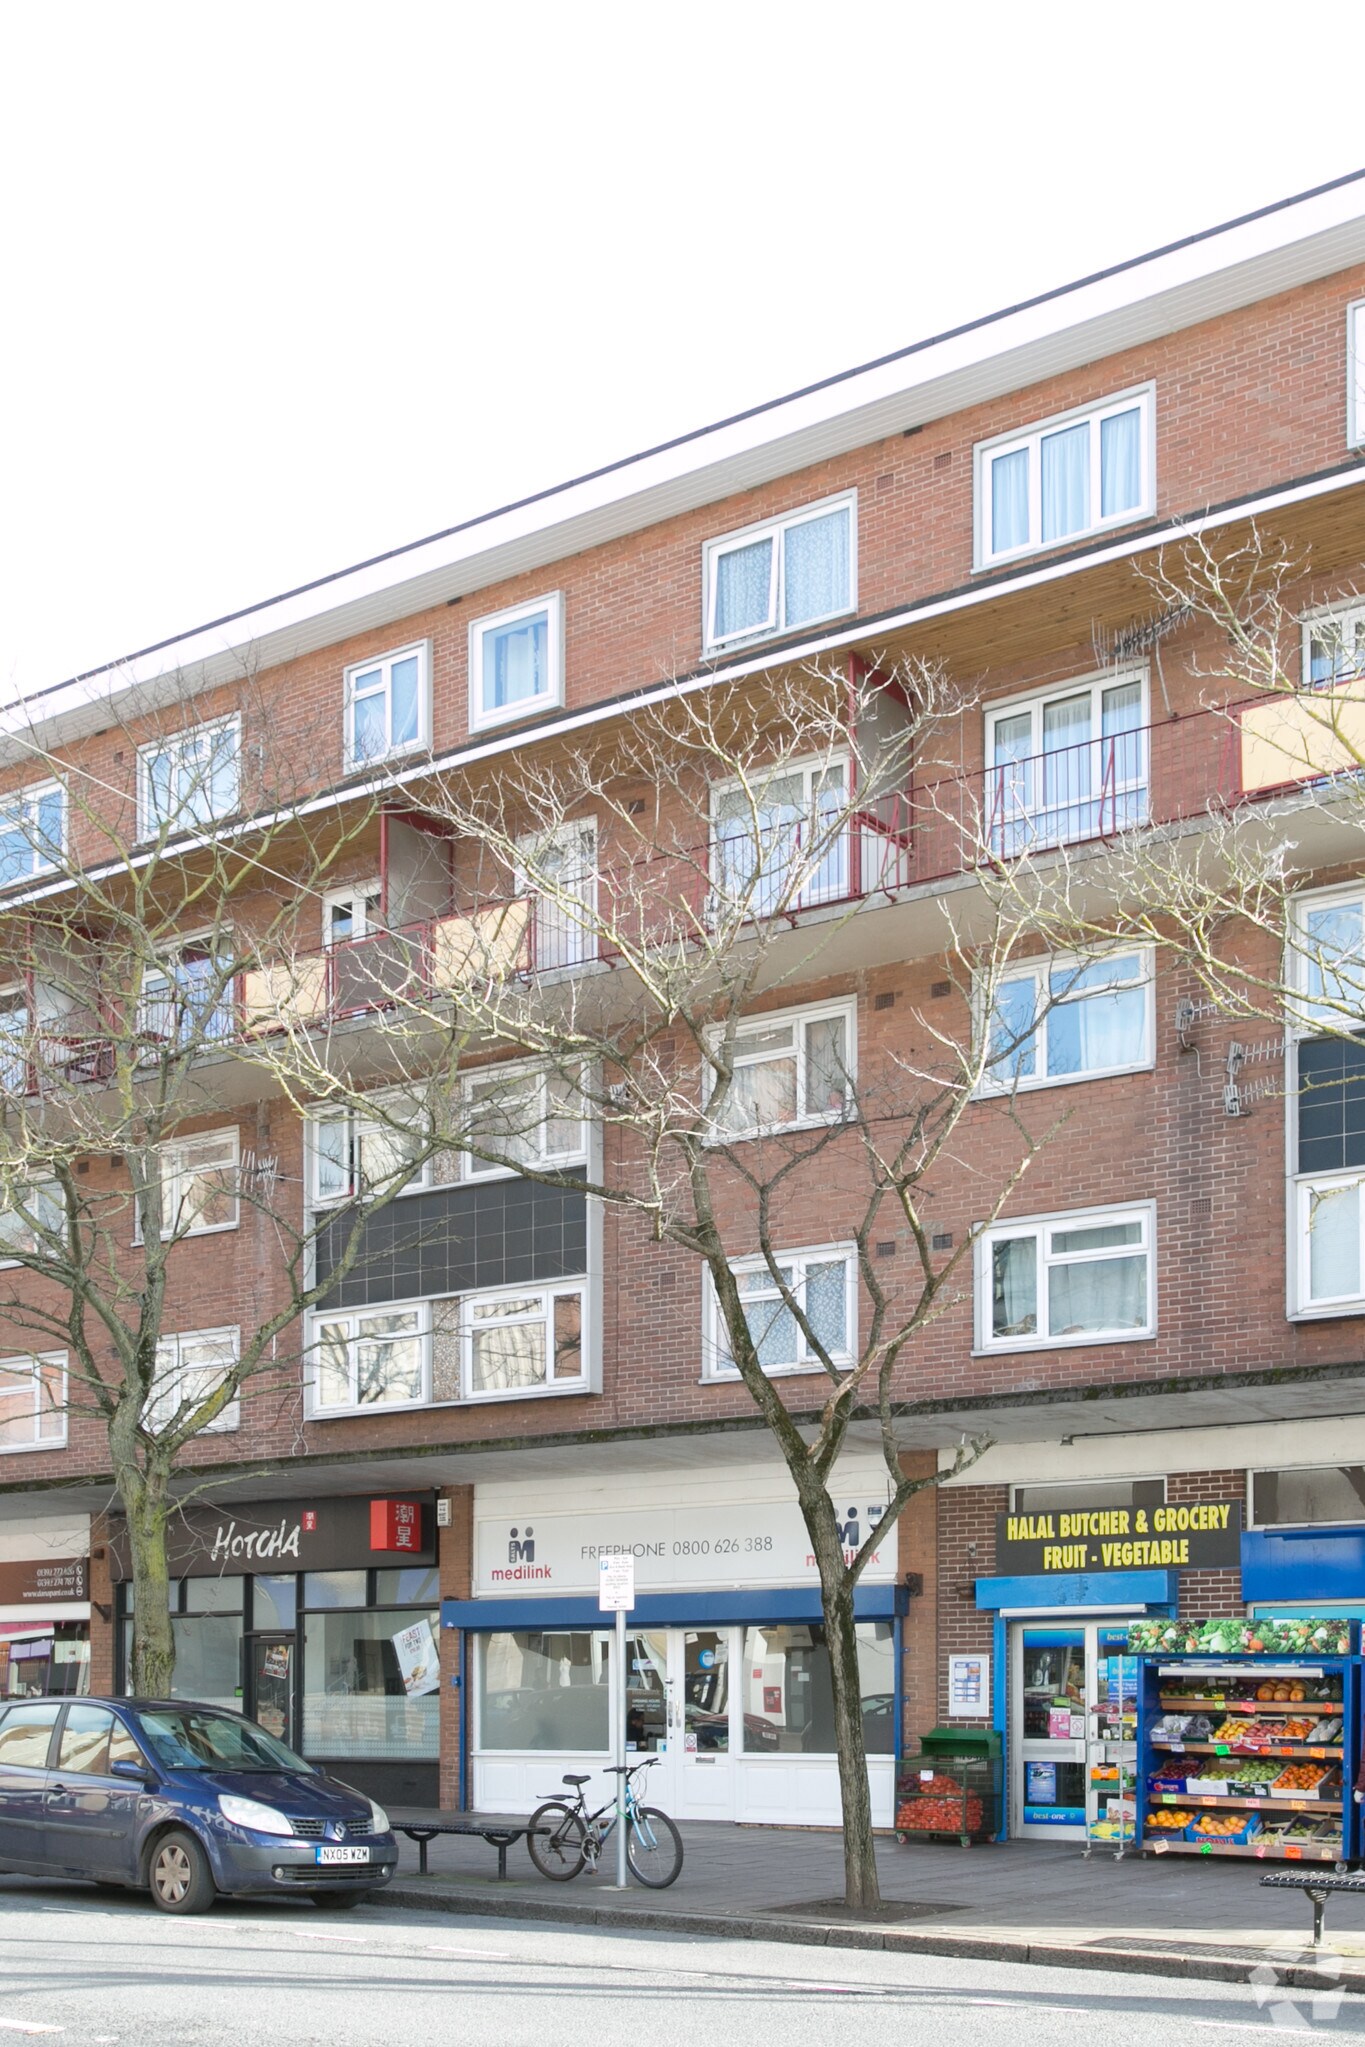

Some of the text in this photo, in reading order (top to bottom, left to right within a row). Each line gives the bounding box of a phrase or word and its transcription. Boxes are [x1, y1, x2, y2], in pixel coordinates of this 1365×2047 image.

[1007, 1504, 1231, 1541] HALAL BUTCHER & GROCERY
[581, 1536, 773, 1560] FREEPHONE 0800 626 388
[1044, 1544, 1088, 1570] FRUIT
[1102, 1538, 1189, 1567] VEGETABLE
[491, 1565, 552, 1581] medilink
[1033, 1811, 1066, 1819] best-one
[323, 1848, 367, 1860] NX05 WZM
